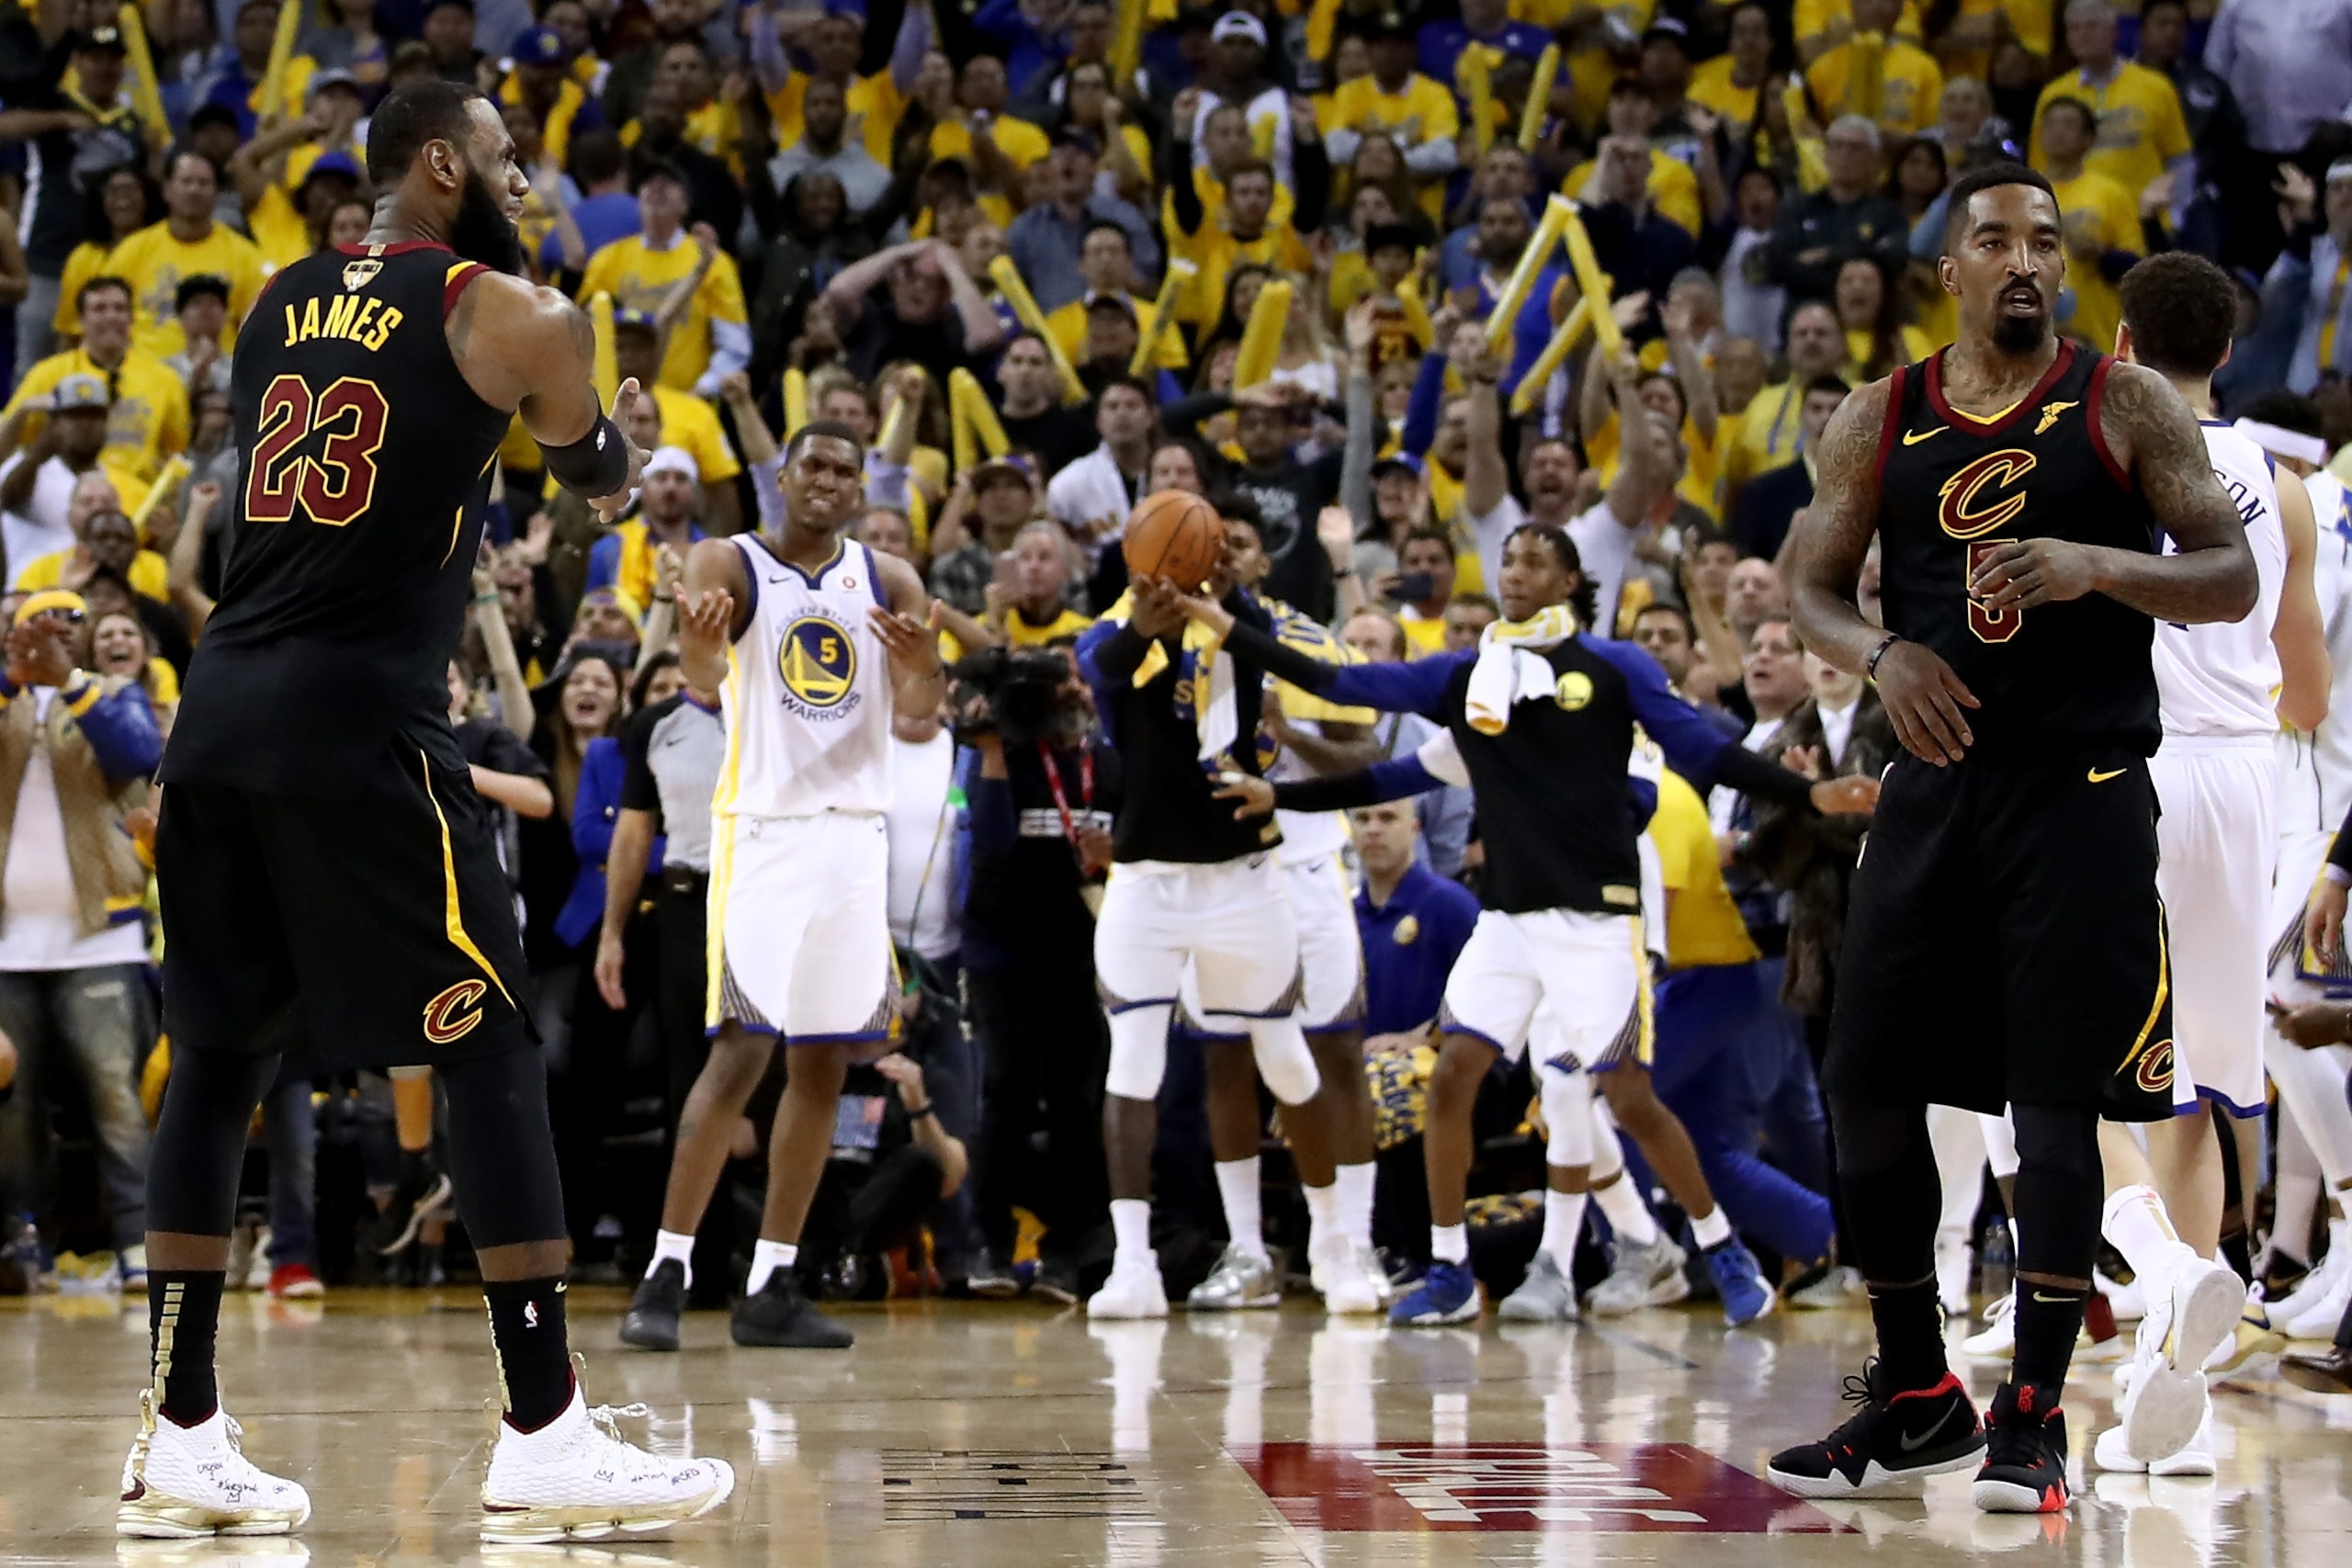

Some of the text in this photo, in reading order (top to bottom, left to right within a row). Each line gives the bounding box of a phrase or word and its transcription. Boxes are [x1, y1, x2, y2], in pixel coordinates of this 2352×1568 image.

[284, 294, 403, 352] JAMES
[245, 375, 390, 527] 23
[820, 637, 838, 664] 5
[781, 690, 861, 722] WARRIORS
[1349, 1449, 1710, 1523] ORACLE
